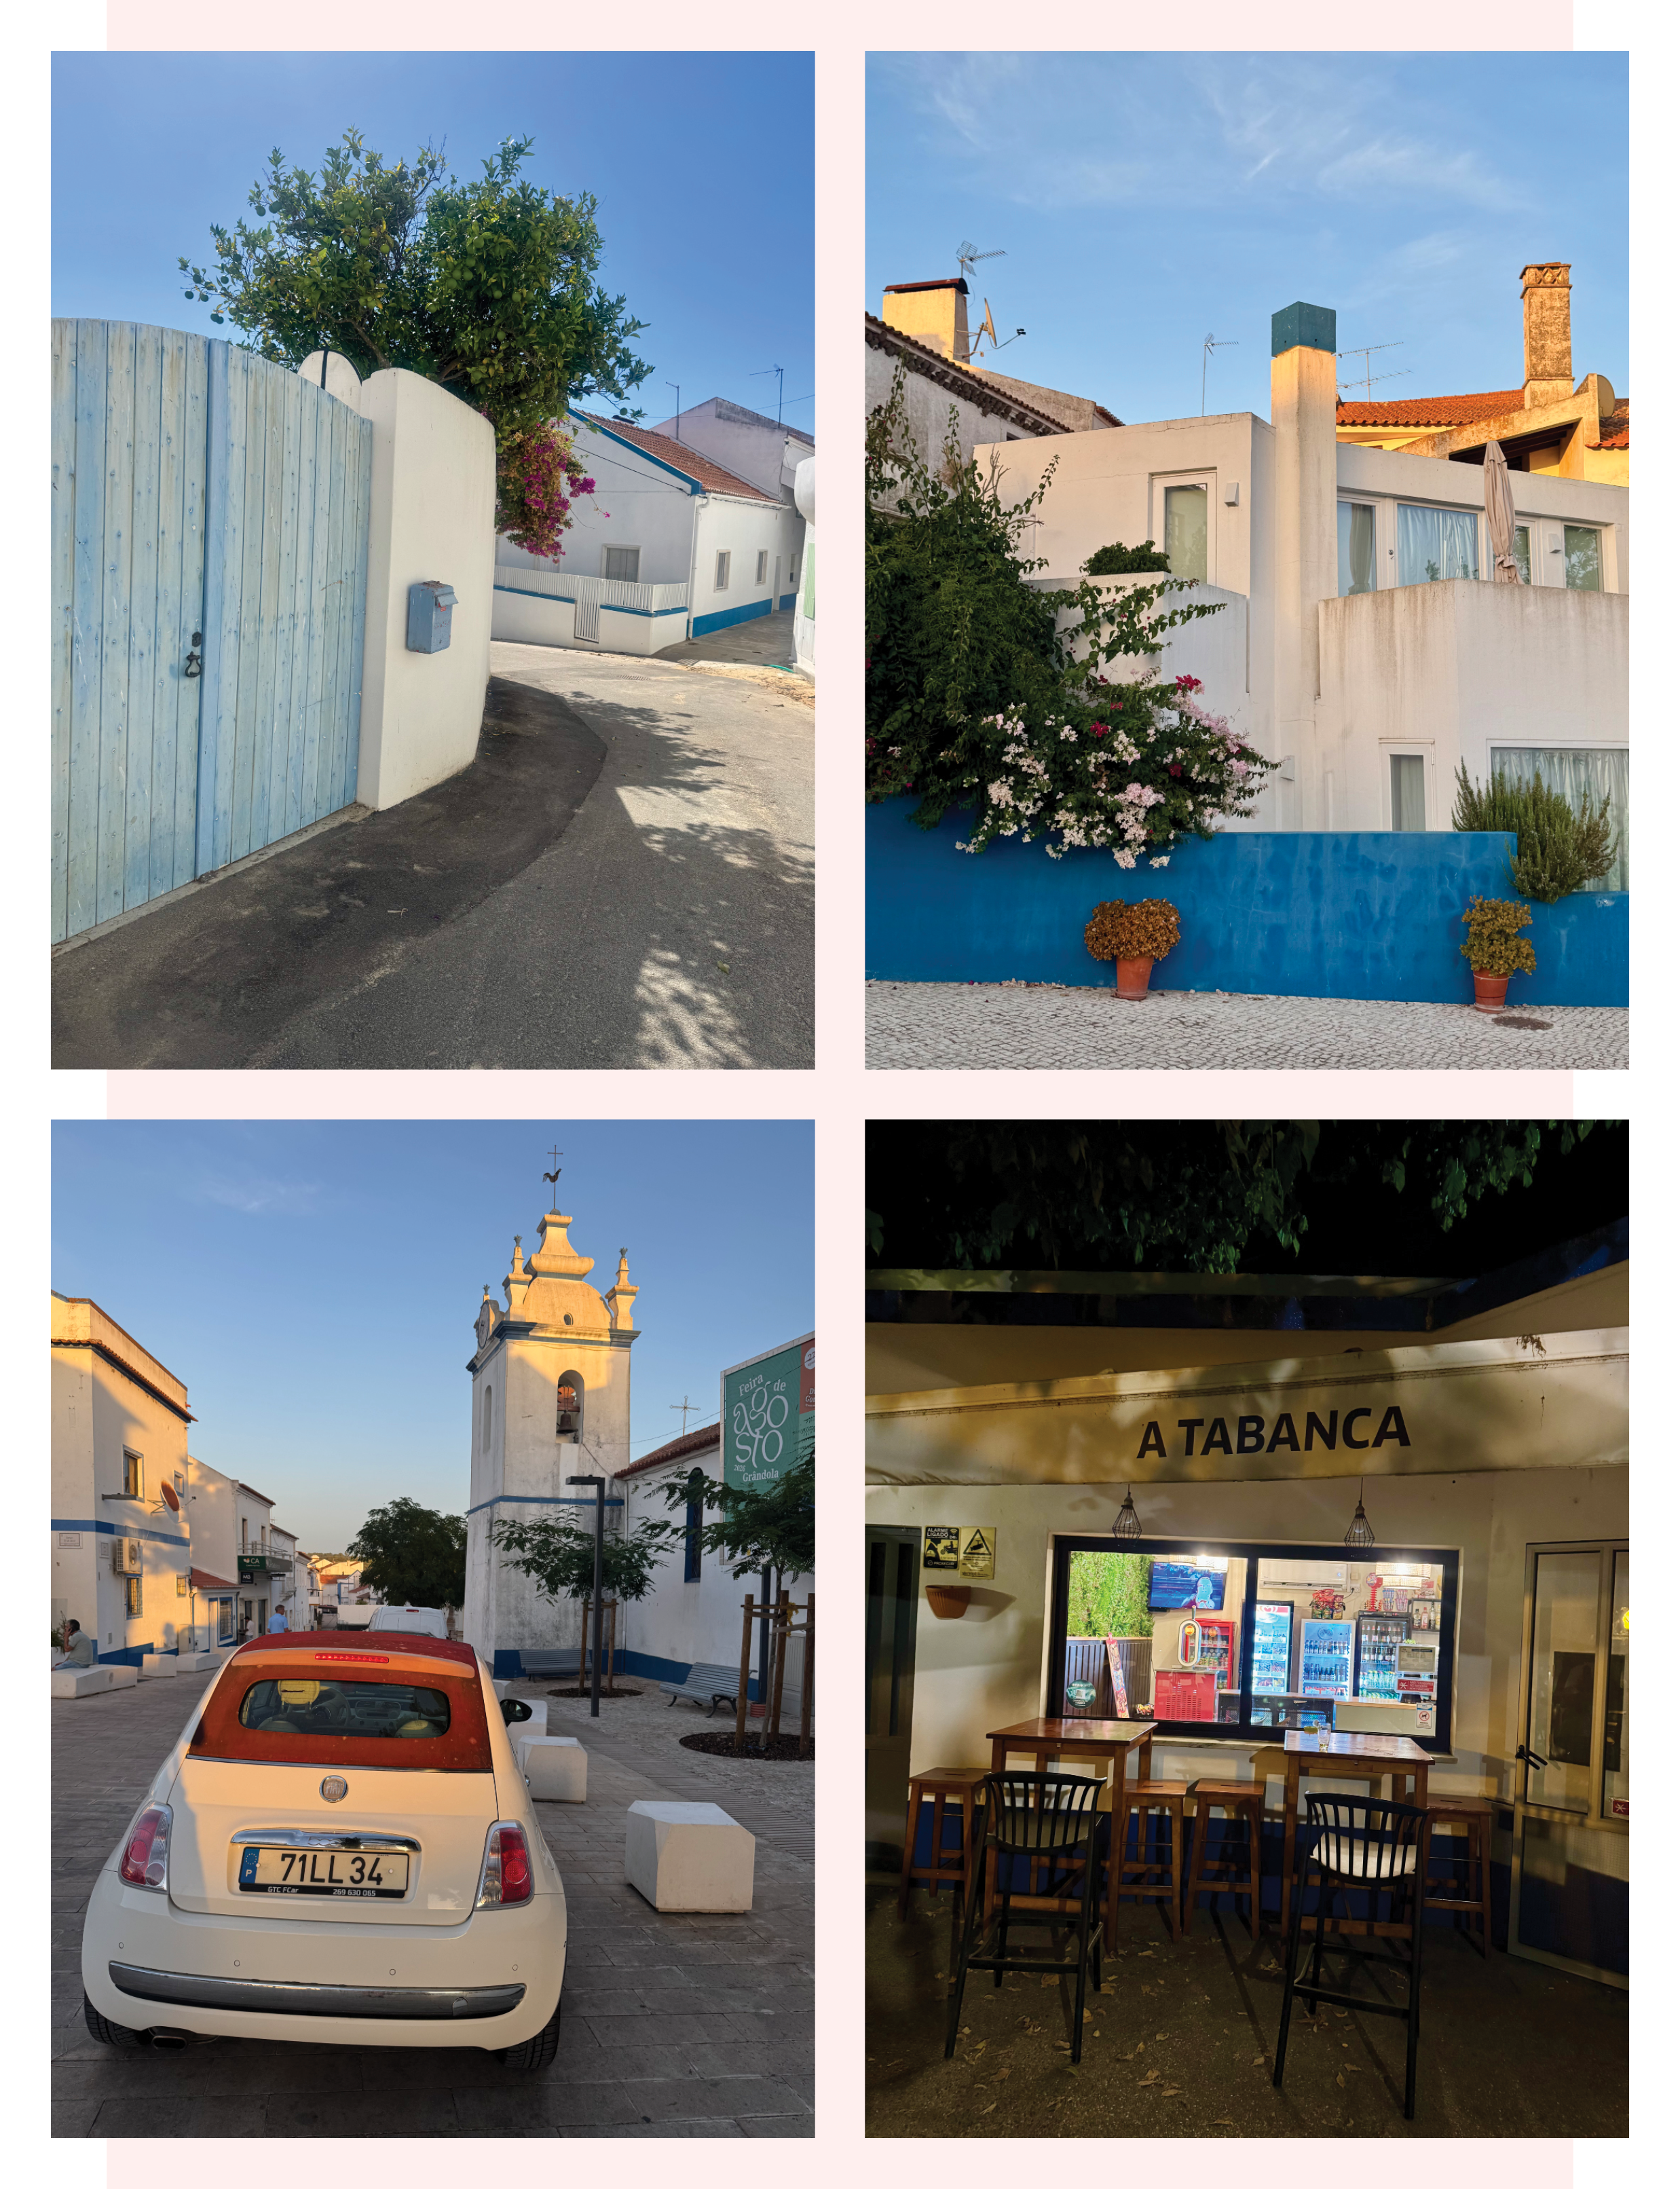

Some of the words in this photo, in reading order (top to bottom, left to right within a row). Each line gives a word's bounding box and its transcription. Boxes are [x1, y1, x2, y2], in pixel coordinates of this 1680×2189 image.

[739, 1374, 764, 1397] Feira
[773, 1379, 786, 1391] de
[1136, 1421, 1168, 1459] A
[1178, 1406, 1411, 1456] TABANCA
[743, 1468, 779, 1482] Grândola
